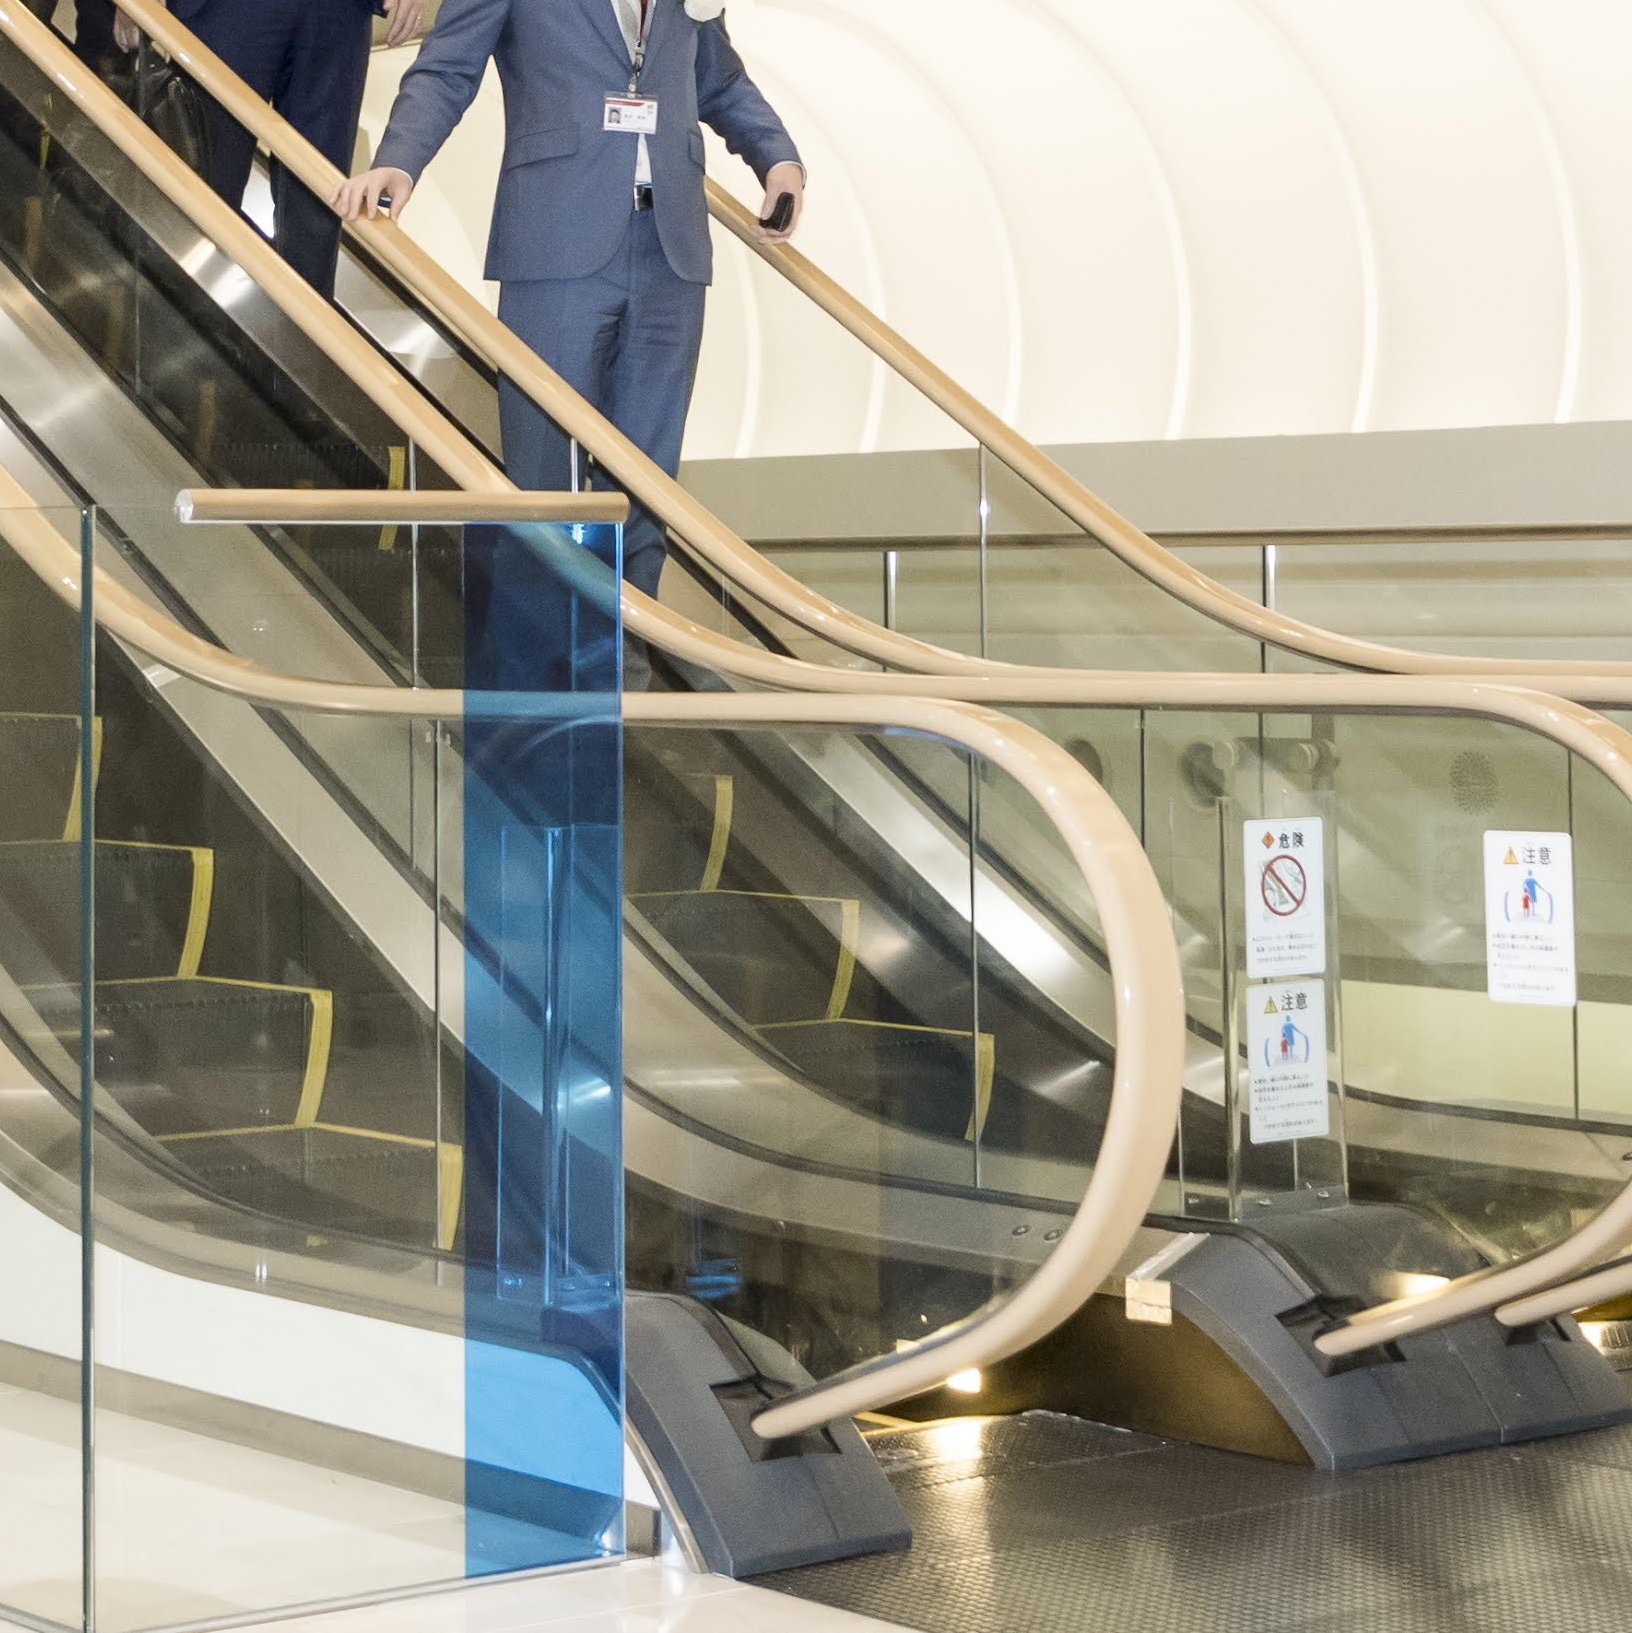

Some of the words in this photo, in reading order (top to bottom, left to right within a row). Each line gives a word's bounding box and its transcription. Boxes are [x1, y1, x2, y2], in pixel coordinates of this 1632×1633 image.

[1279, 831, 1305, 849] 危険
[1522, 846, 1552, 865] 注意
[1281, 992, 1308, 1011] 注意
